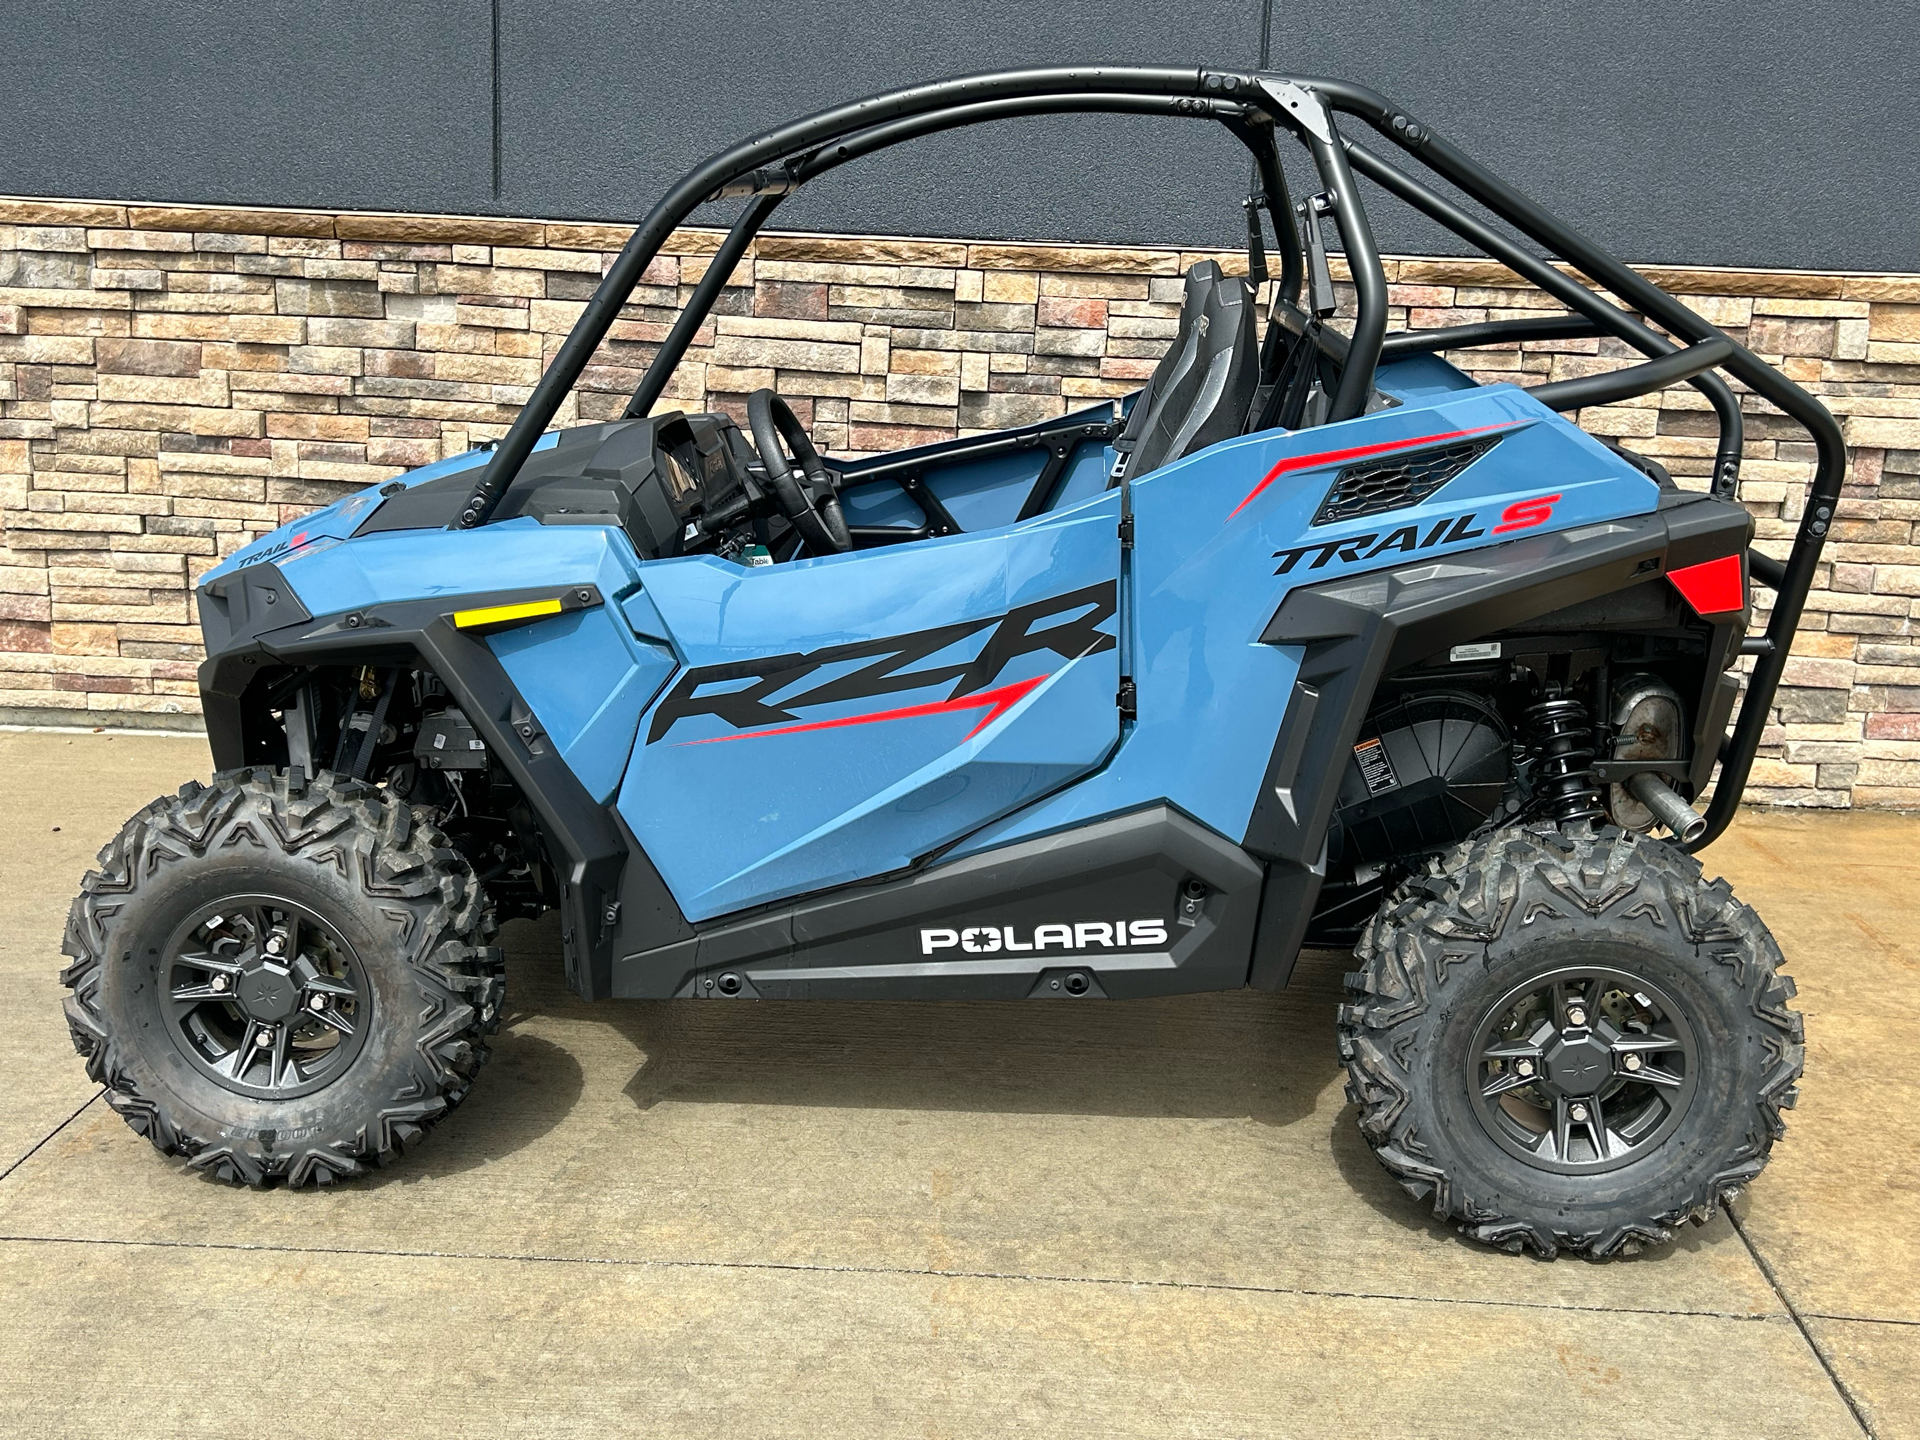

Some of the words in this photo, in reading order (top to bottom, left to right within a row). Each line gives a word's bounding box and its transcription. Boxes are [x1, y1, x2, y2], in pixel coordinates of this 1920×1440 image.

[238, 541, 289, 569] TRAIL
[1272, 513, 1486, 576] TRAIL
[1490, 493, 1563, 536] S
[646, 578, 1117, 746] RZR
[920, 919, 1168, 955] POLARIS
